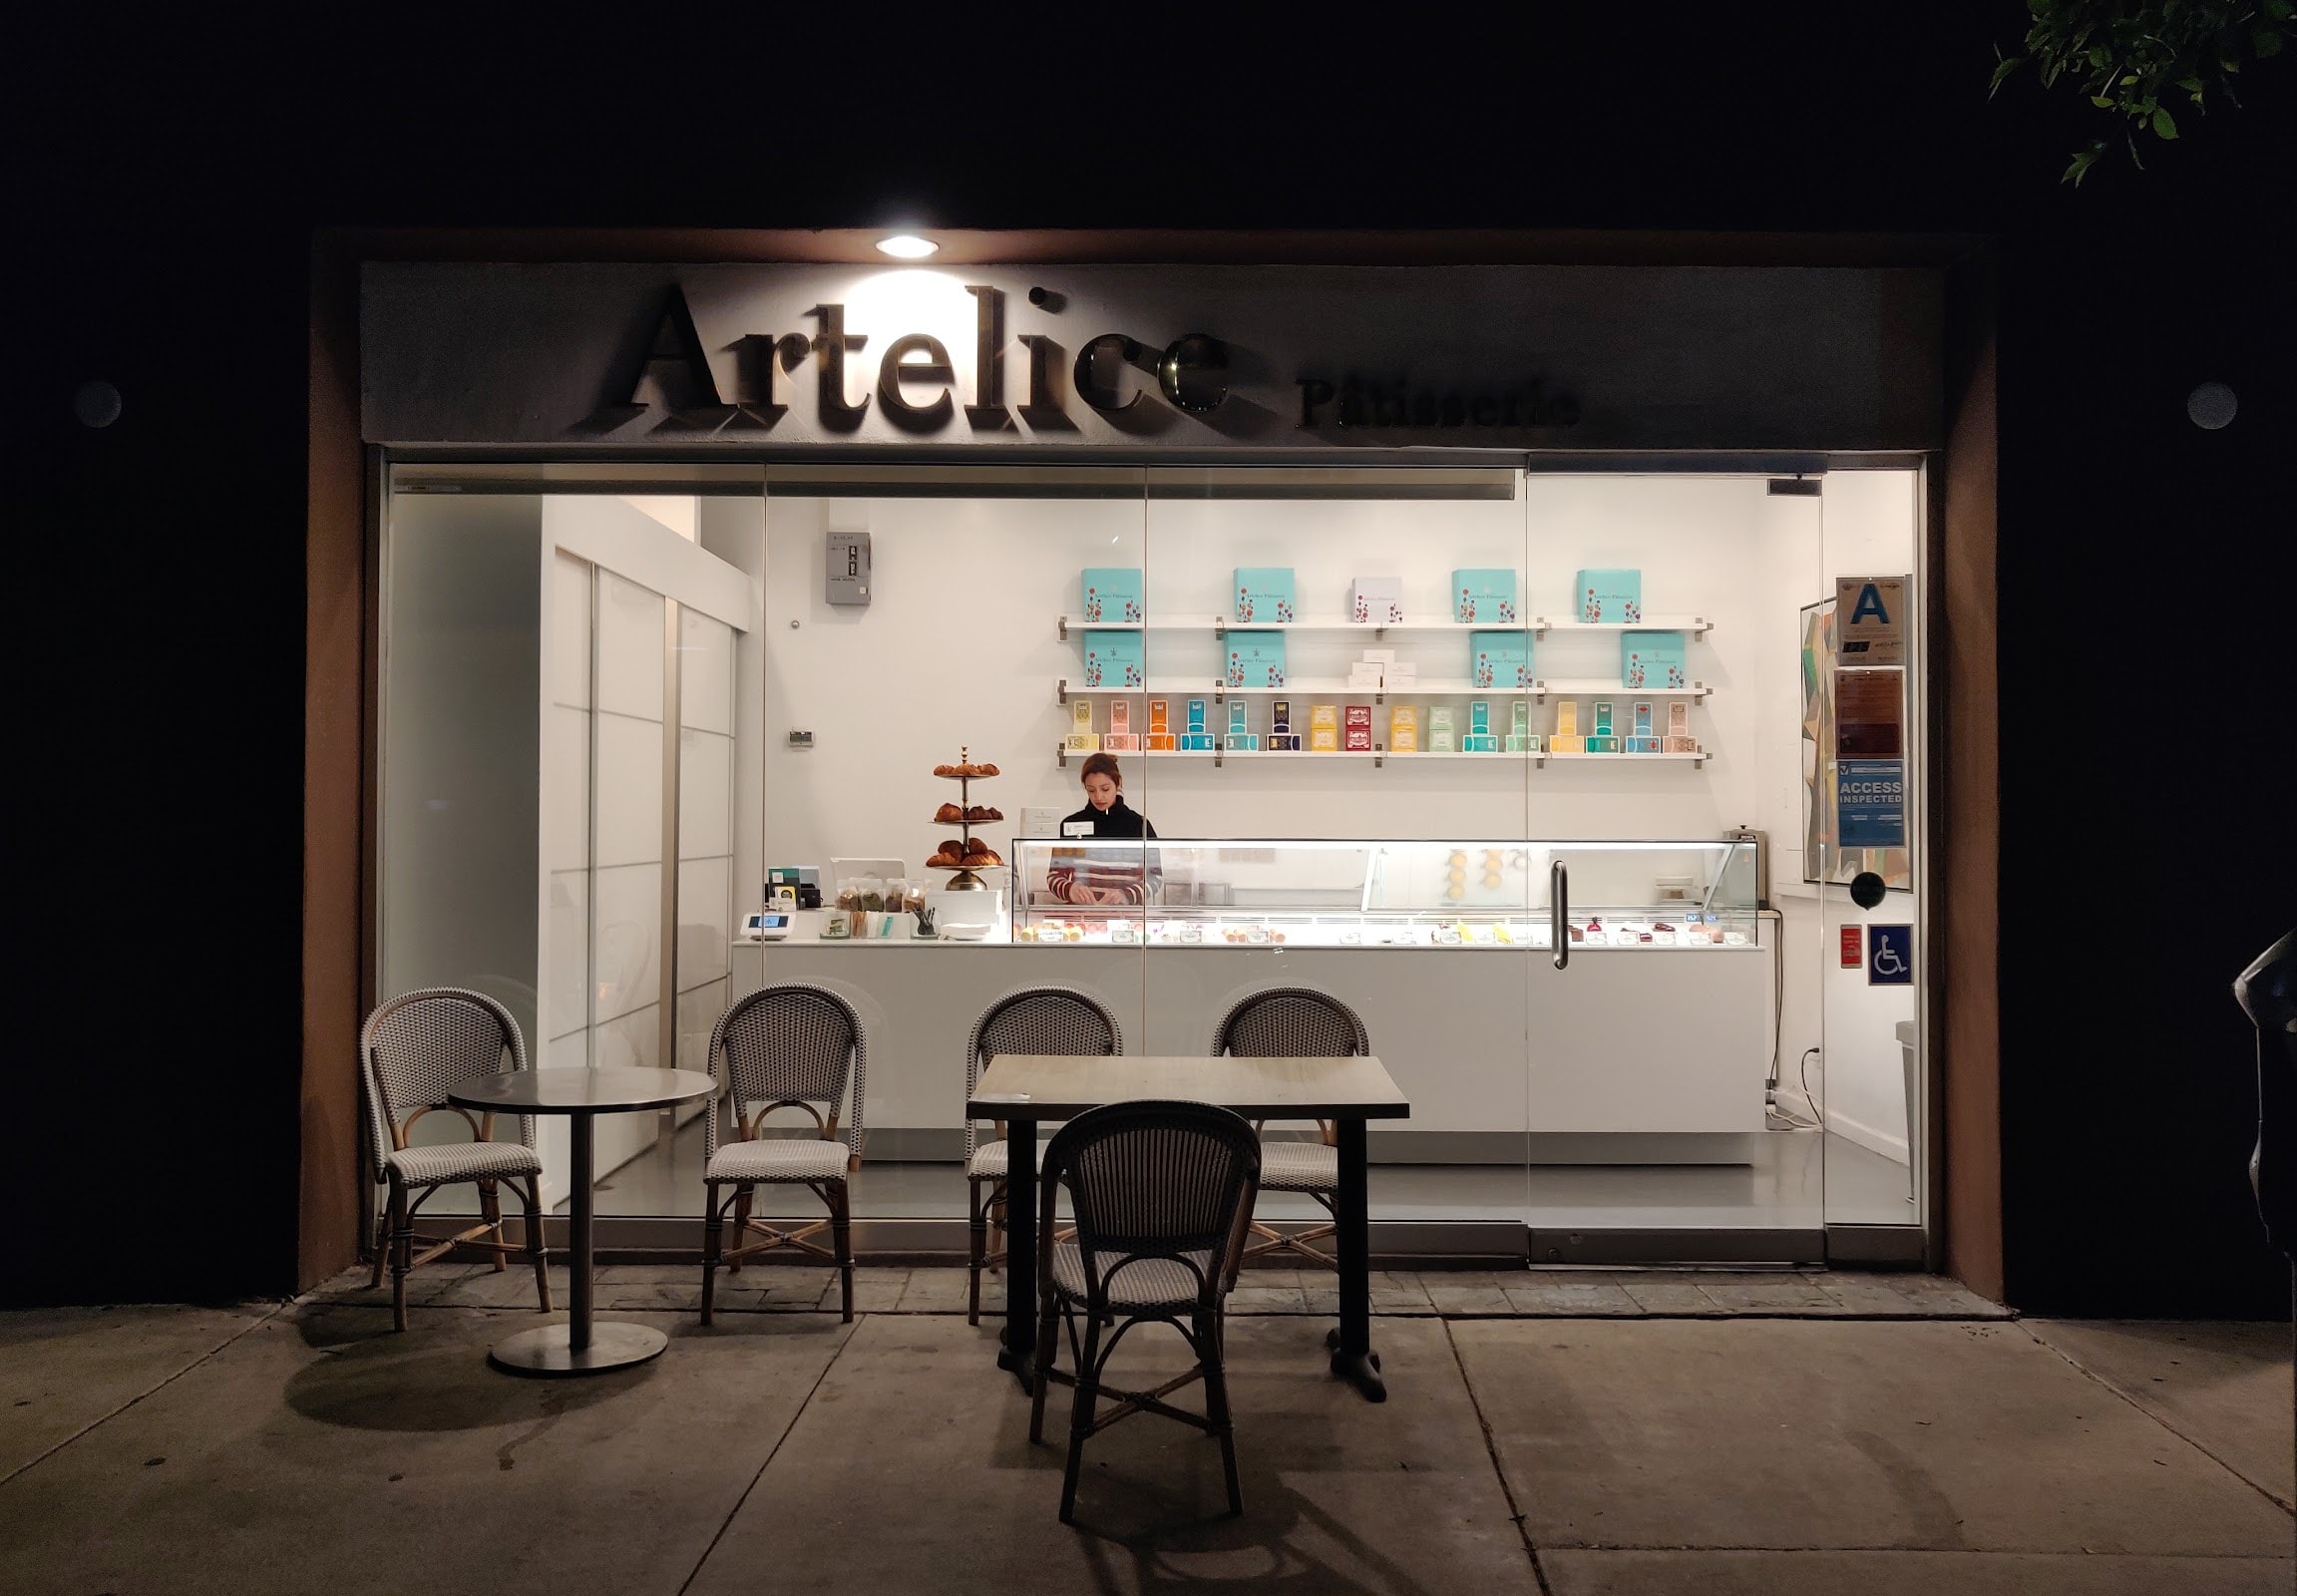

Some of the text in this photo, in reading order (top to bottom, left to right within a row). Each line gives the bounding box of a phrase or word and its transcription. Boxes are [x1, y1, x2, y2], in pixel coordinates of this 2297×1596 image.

[630, 283, 1230, 412] Artelice
[1850, 584, 1889, 623] A
[1839, 782, 1902, 794] ACCESS
[1839, 794, 1902, 804] INSPECTED
